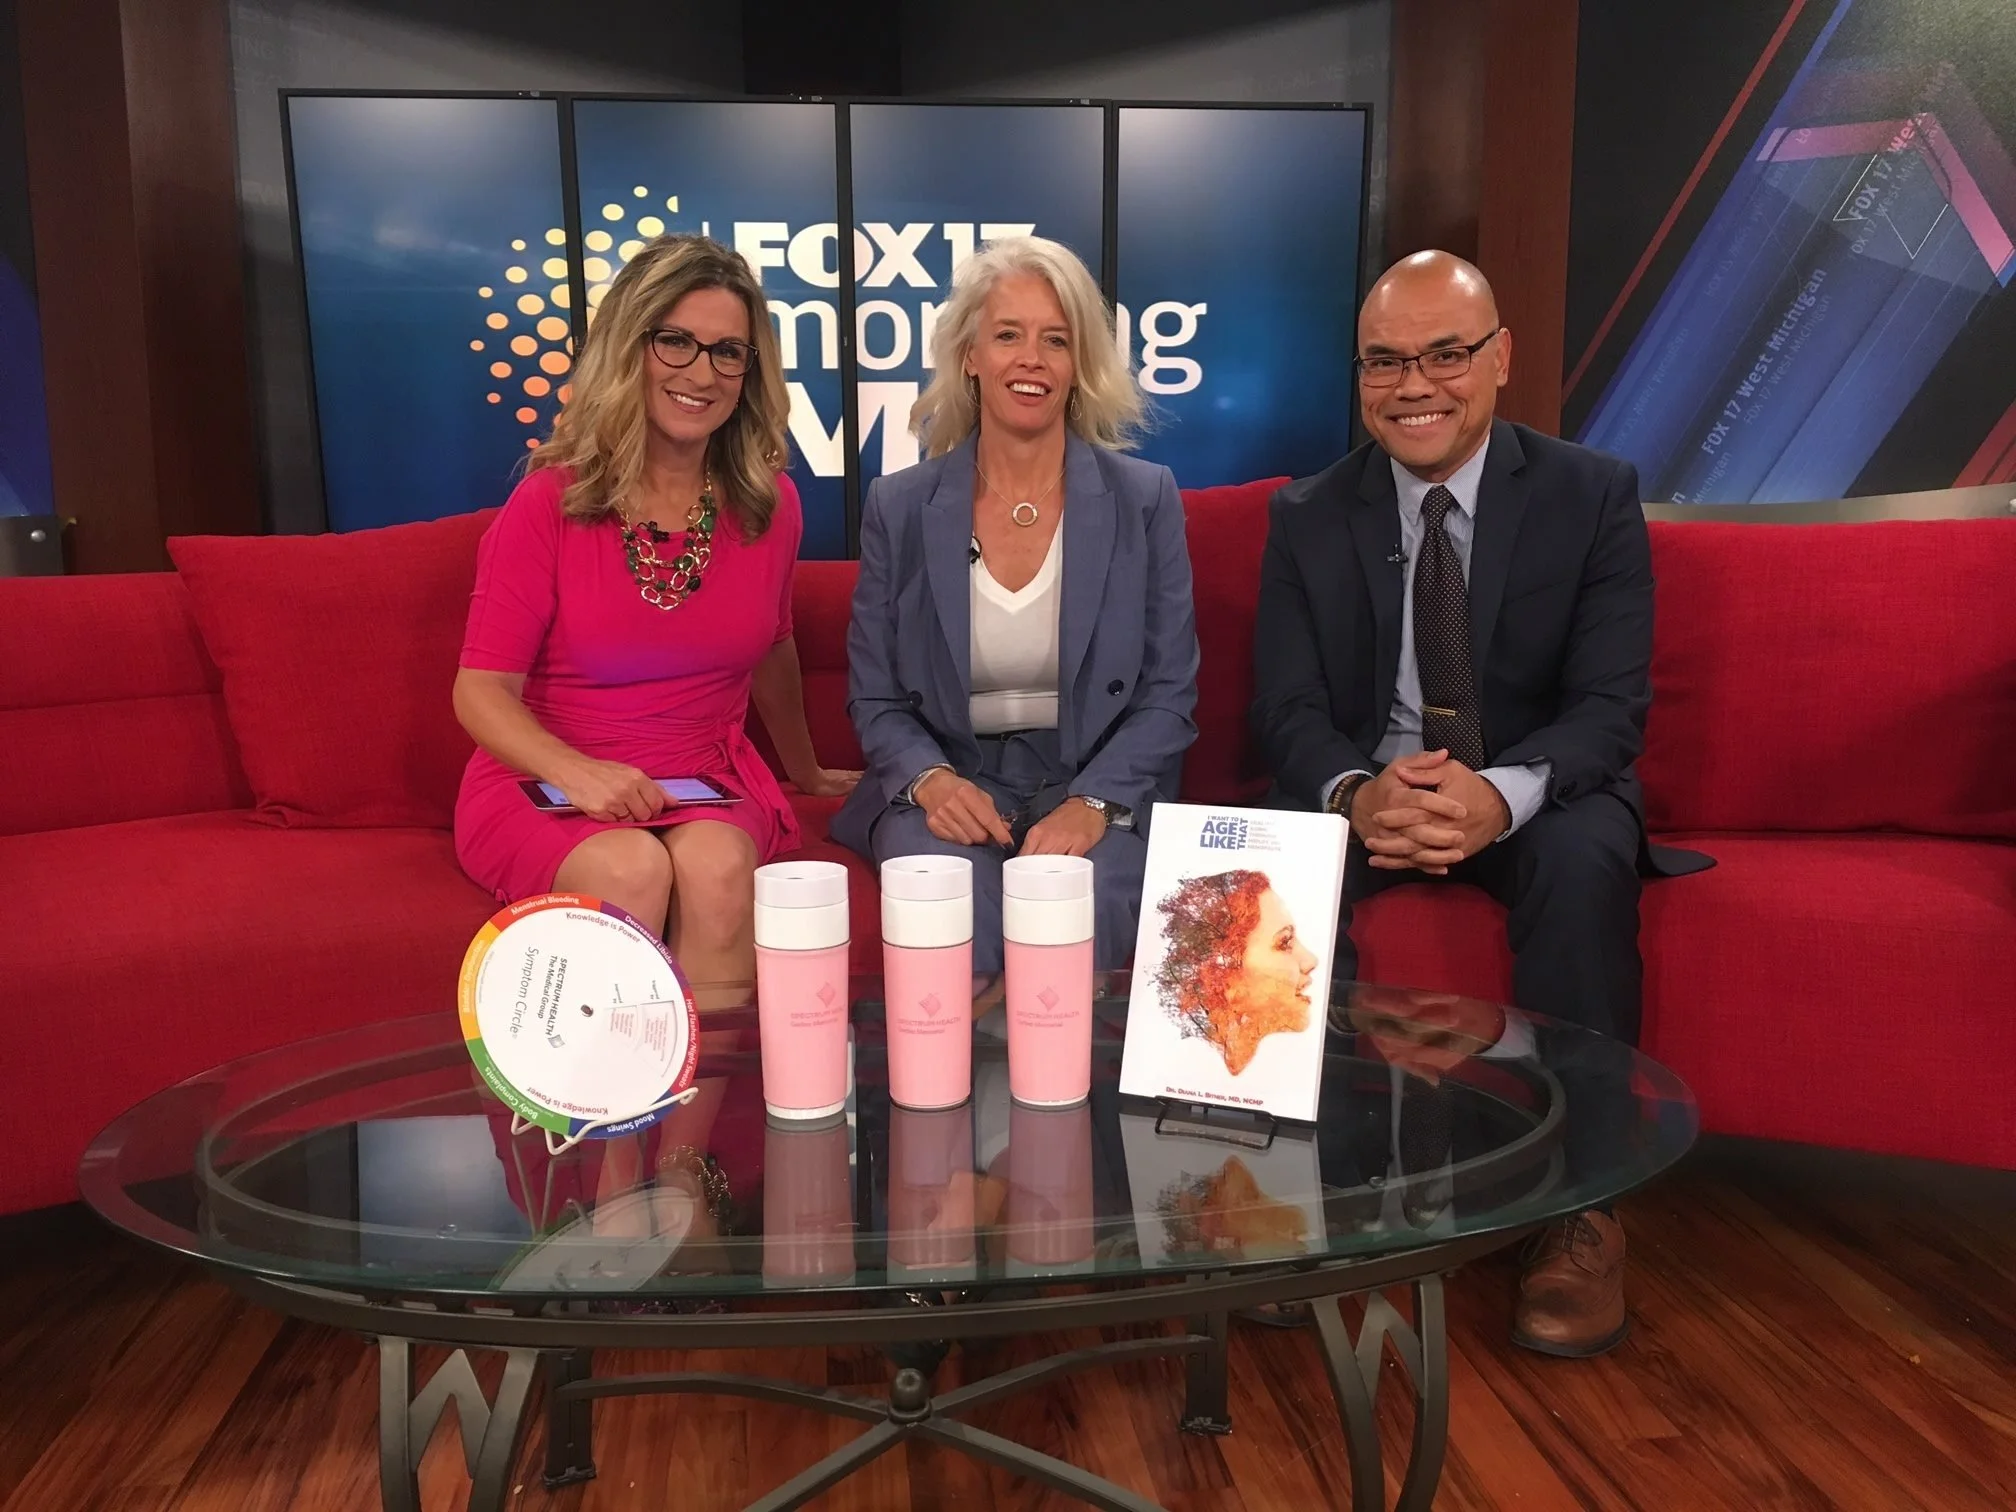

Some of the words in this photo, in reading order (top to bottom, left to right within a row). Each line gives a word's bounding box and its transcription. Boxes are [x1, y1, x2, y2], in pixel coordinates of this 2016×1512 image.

[1848, 183, 1880, 219] FOX
[1873, 158, 1893, 180] 17
[733, 222, 937, 288] FOX
[768, 299, 1206, 394] morg
[1701, 421, 1730, 455] FOX
[1724, 399, 1742, 420] 17
[1736, 353, 1774, 399] West
[1765, 268, 1828, 352] Michigan
[1743, 401, 1764, 426] FOX
[1758, 387, 1772, 400] 17
[1767, 354, 1791, 387] West
[1788, 294, 1833, 352] Michigan
[1692, 451, 1733, 504] Michigan
[1200, 834, 1237, 850] LIKE
[1202, 821, 1238, 836] AGE
[1237, 818, 1248, 850] THAT
[510, 896, 546, 916] Menstrual
[547, 896, 580, 905] Bleeding
[566, 911, 609, 927] Knowledge
[610, 922, 617, 930] is
[618, 926, 640, 943] Power
[625, 916, 658, 945] Decreased
[656, 943, 672, 964] Libido
[518, 946, 539, 999] Symptom
[547, 955, 557, 967] The
[543, 969, 555, 997] Medical
[554, 957, 568, 1003] SPECTRUM
[538, 997, 549, 1019] Group
[545, 1004, 558, 1036] HEALTH
[485, 1067, 519, 1106] Complaints
[678, 1065, 693, 1088] Sweats
[520, 1104, 538, 1119] Body
[526, 1087, 551, 1105] Power
[569, 1102, 608, 1115] Knowledge
[607, 1120, 634, 1133] Swings
[632, 1113, 655, 1127] Mood
